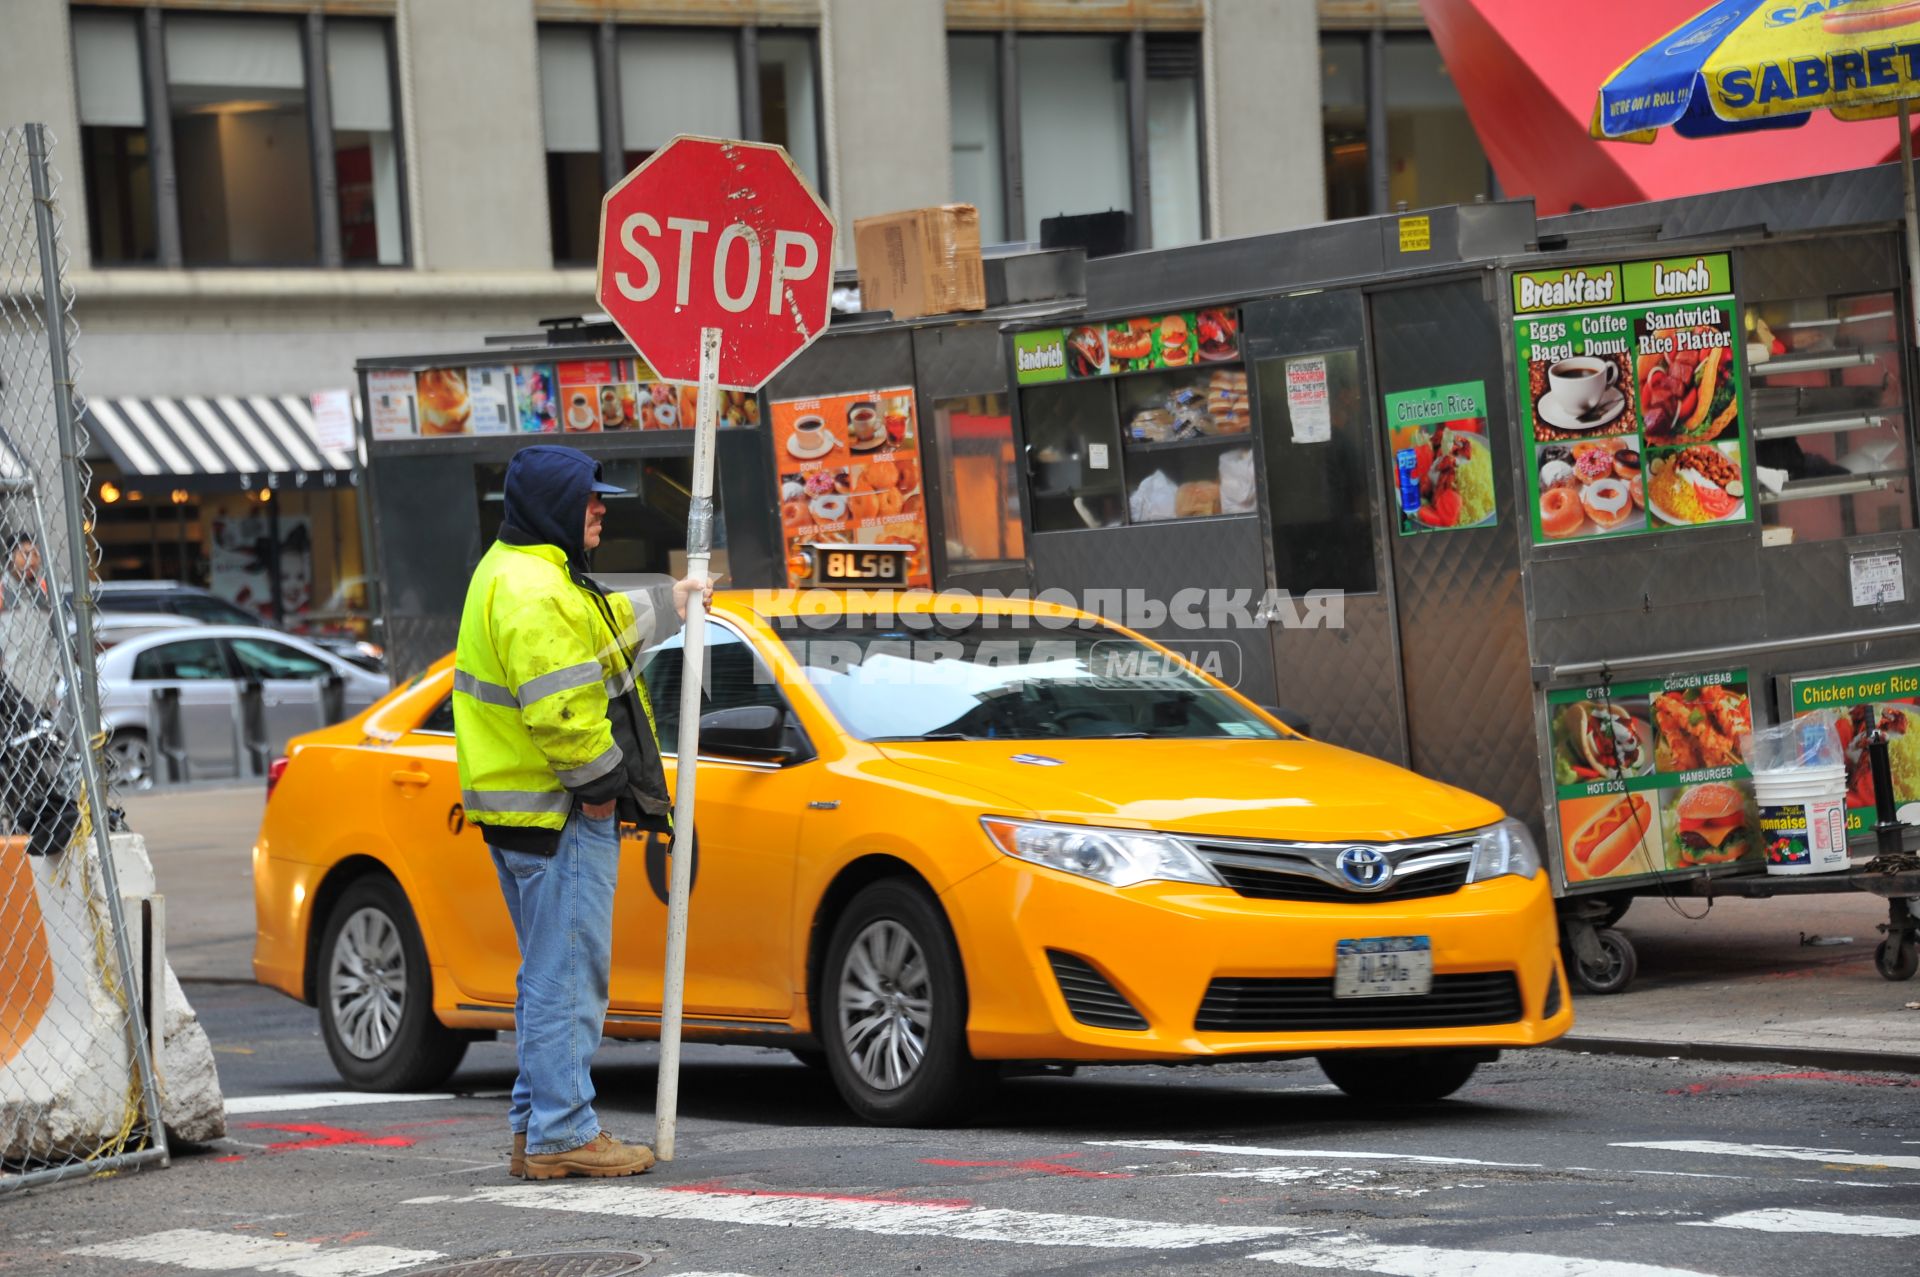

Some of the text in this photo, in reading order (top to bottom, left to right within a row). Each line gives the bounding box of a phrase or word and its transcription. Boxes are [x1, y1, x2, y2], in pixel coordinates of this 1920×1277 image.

[1653, 90, 1675, 107] ROLL
[614, 212, 819, 316] STOP
[1520, 271, 1615, 308] Breakfast
[1655, 259, 1710, 296] Lunch
[1530, 316, 1627, 342] Eggs Coffee
[1645, 305, 1721, 331] Sandwich
[1018, 341, 1063, 371] Sandwich
[1531, 337, 1627, 363] Bagel Donut
[1639, 330, 1731, 356] Rice Platter
[1398, 395, 1475, 421] Chicken Rice
[827, 553, 896, 578] 8L58
[1664, 672, 1732, 690] CHICKEN KEBAB
[1803, 676, 1918, 704] Chicken over Rice
[1587, 780, 1625, 795] HOT DOG
[1680, 767, 1733, 783] HAMBURGER
